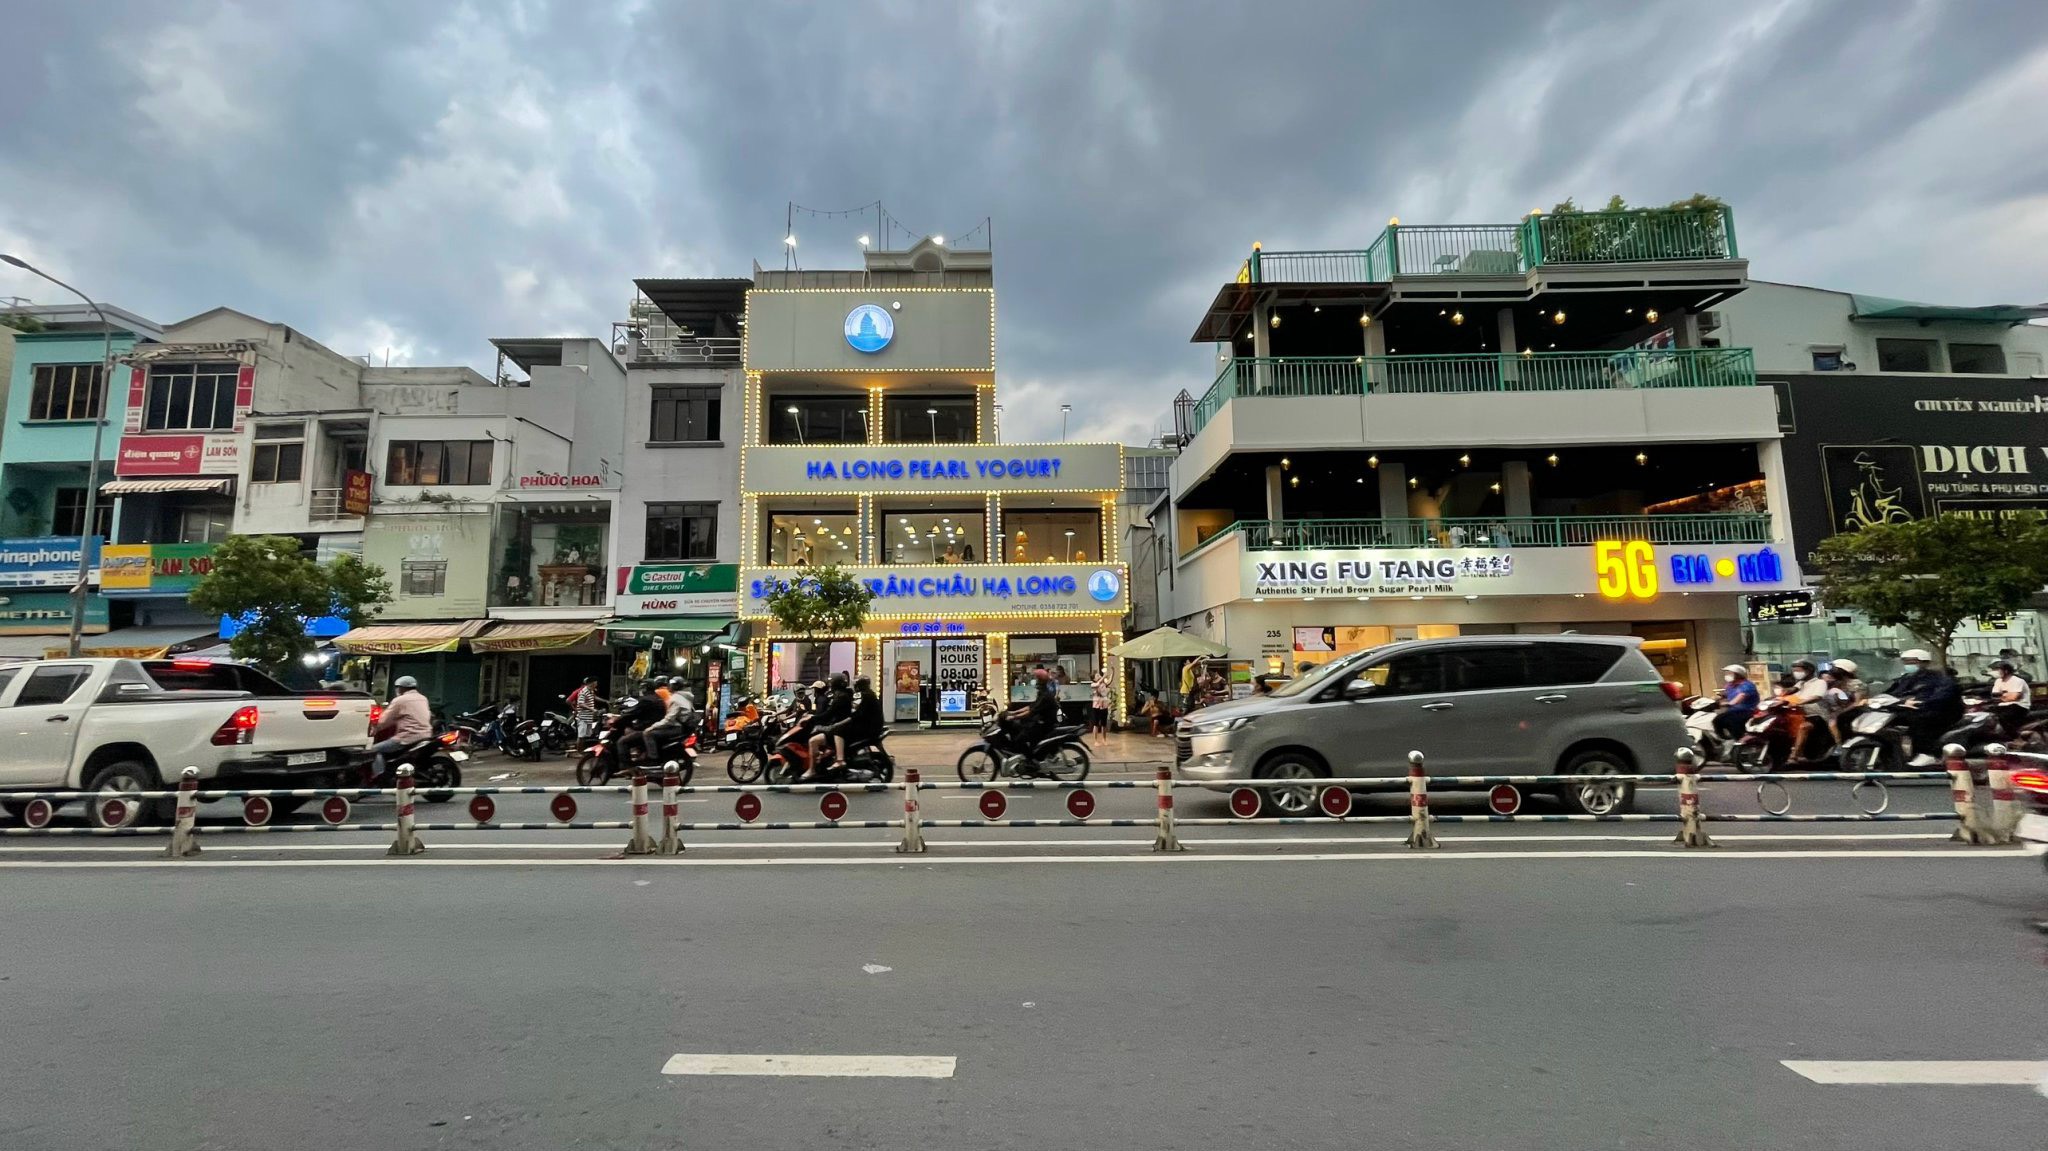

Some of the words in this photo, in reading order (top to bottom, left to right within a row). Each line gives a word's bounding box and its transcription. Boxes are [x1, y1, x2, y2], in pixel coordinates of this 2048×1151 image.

[206, 446, 222, 457] LAM
[1920, 445, 2031, 478] DỊCH
[842, 460, 904, 479] LONG
[908, 460, 971, 479] PEARL
[975, 458, 1062, 479] YOGURT
[571, 475, 600, 486] HOA
[1982, 483, 1990, 493] &
[1258, 561, 1328, 581] XING
[1337, 560, 1372, 580] FU
[1379, 559, 1455, 578] TANG
[1596, 540, 1658, 598] 5G
[1671, 554, 1713, 583] BIA
[652, 573, 682, 581] Castrol
[918, 573, 977, 598] CHÂU
[982, 576, 1012, 600] HẠ
[1016, 575, 1077, 596] LONG
[1255, 586, 1297, 595] Authentic
[1301, 586, 1318, 594] Stir
[1320, 586, 1344, 594] Fried
[1347, 586, 1375, 594] Brown
[1378, 585, 1405, 594] Sugar
[1408, 585, 1432, 593] Pearl
[1435, 584, 1454, 593] Milk
[641, 598, 678, 610] HÙNG
[1266, 630, 1282, 638] 235
[940, 644, 979, 652] OPENING
[940, 654, 978, 663] HOURS
[941, 668, 978, 679] 08:00
